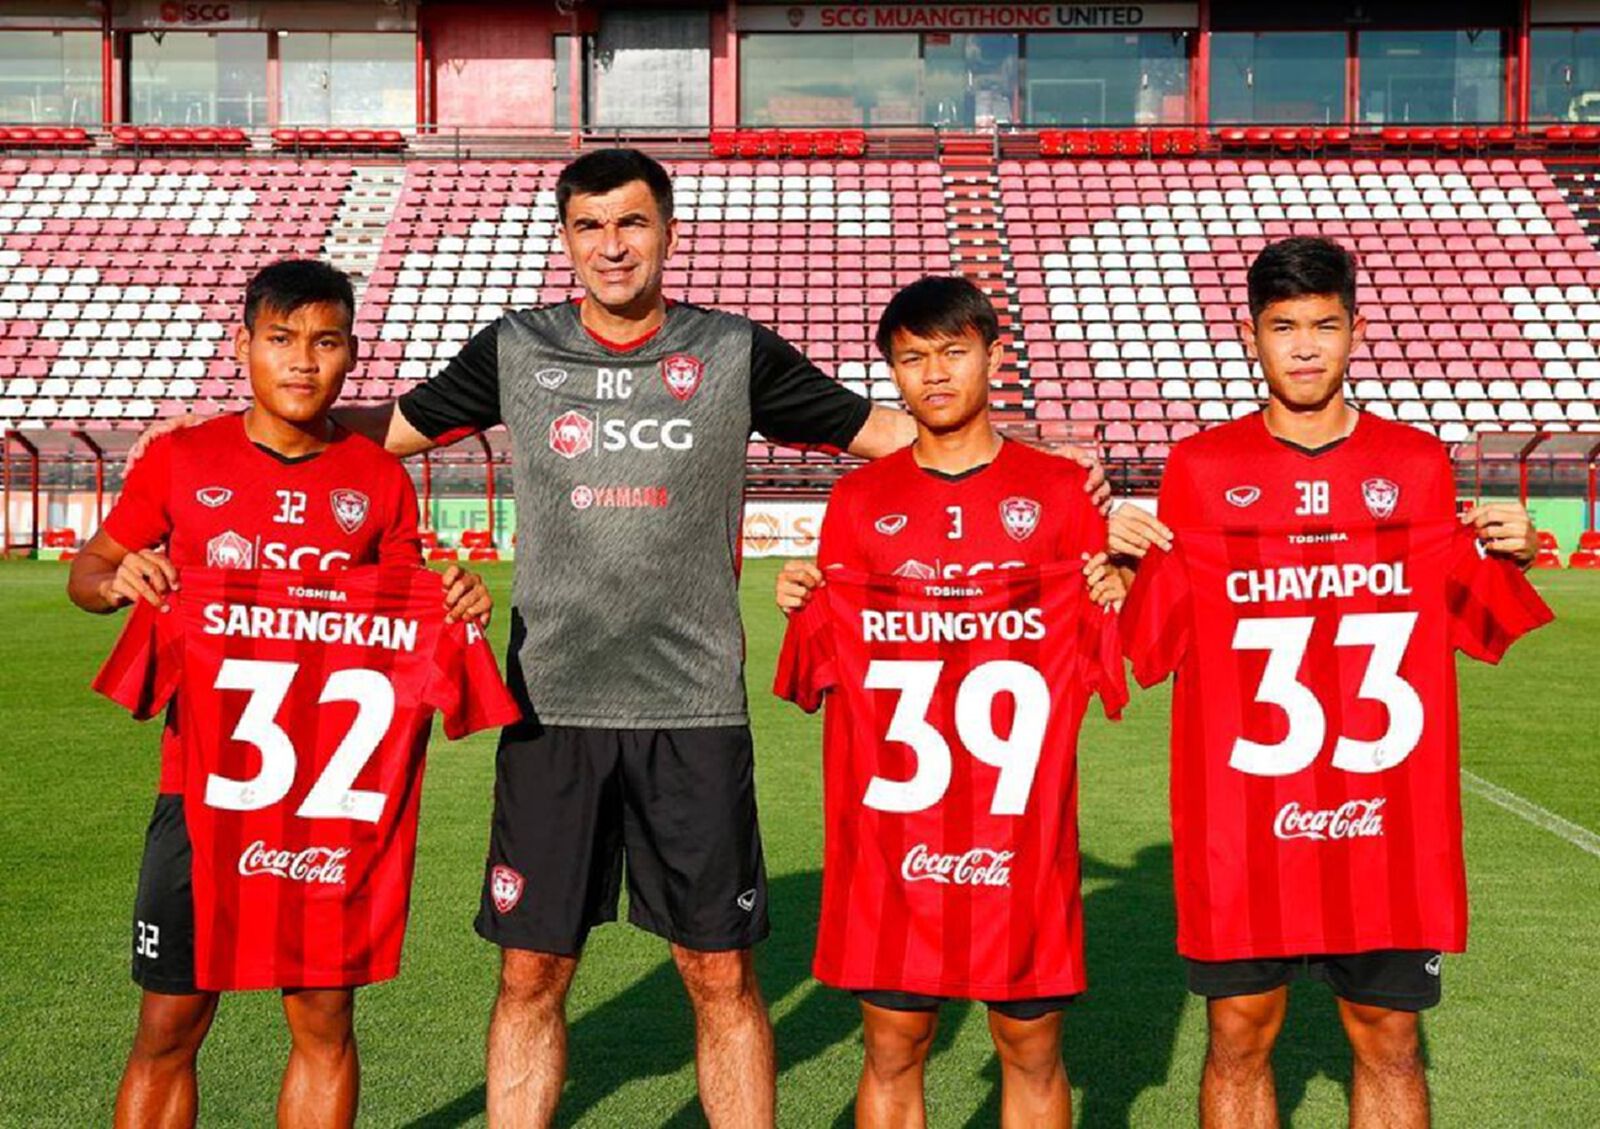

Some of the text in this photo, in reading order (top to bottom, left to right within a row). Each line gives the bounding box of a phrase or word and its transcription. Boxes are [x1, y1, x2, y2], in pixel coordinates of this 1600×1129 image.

[186, 4, 230, 21] SCG
[820, 6, 1144, 27] SCG MUANGTHONG UNITED
[595, 368, 633, 400] RC
[602, 418, 694, 450] SCG
[272, 489, 308, 524] 32
[593, 484, 668, 508] YAMAHA
[1295, 480, 1330, 516] 38
[945, 505, 963, 539] 3
[1287, 532, 1349, 544] TOSHIBA
[287, 586, 347, 601] TOSHIBA
[924, 585, 984, 597] TOSHIBA
[1225, 562, 1413, 604] CHAYAPOL
[202, 602, 418, 652] SARINGKAN
[861, 606, 1047, 643] REUNGYOS
[1228, 611, 1425, 777] 33
[203, 657, 396, 824] 32
[861, 659, 1052, 816] 39
[136, 920, 160, 960] 32
